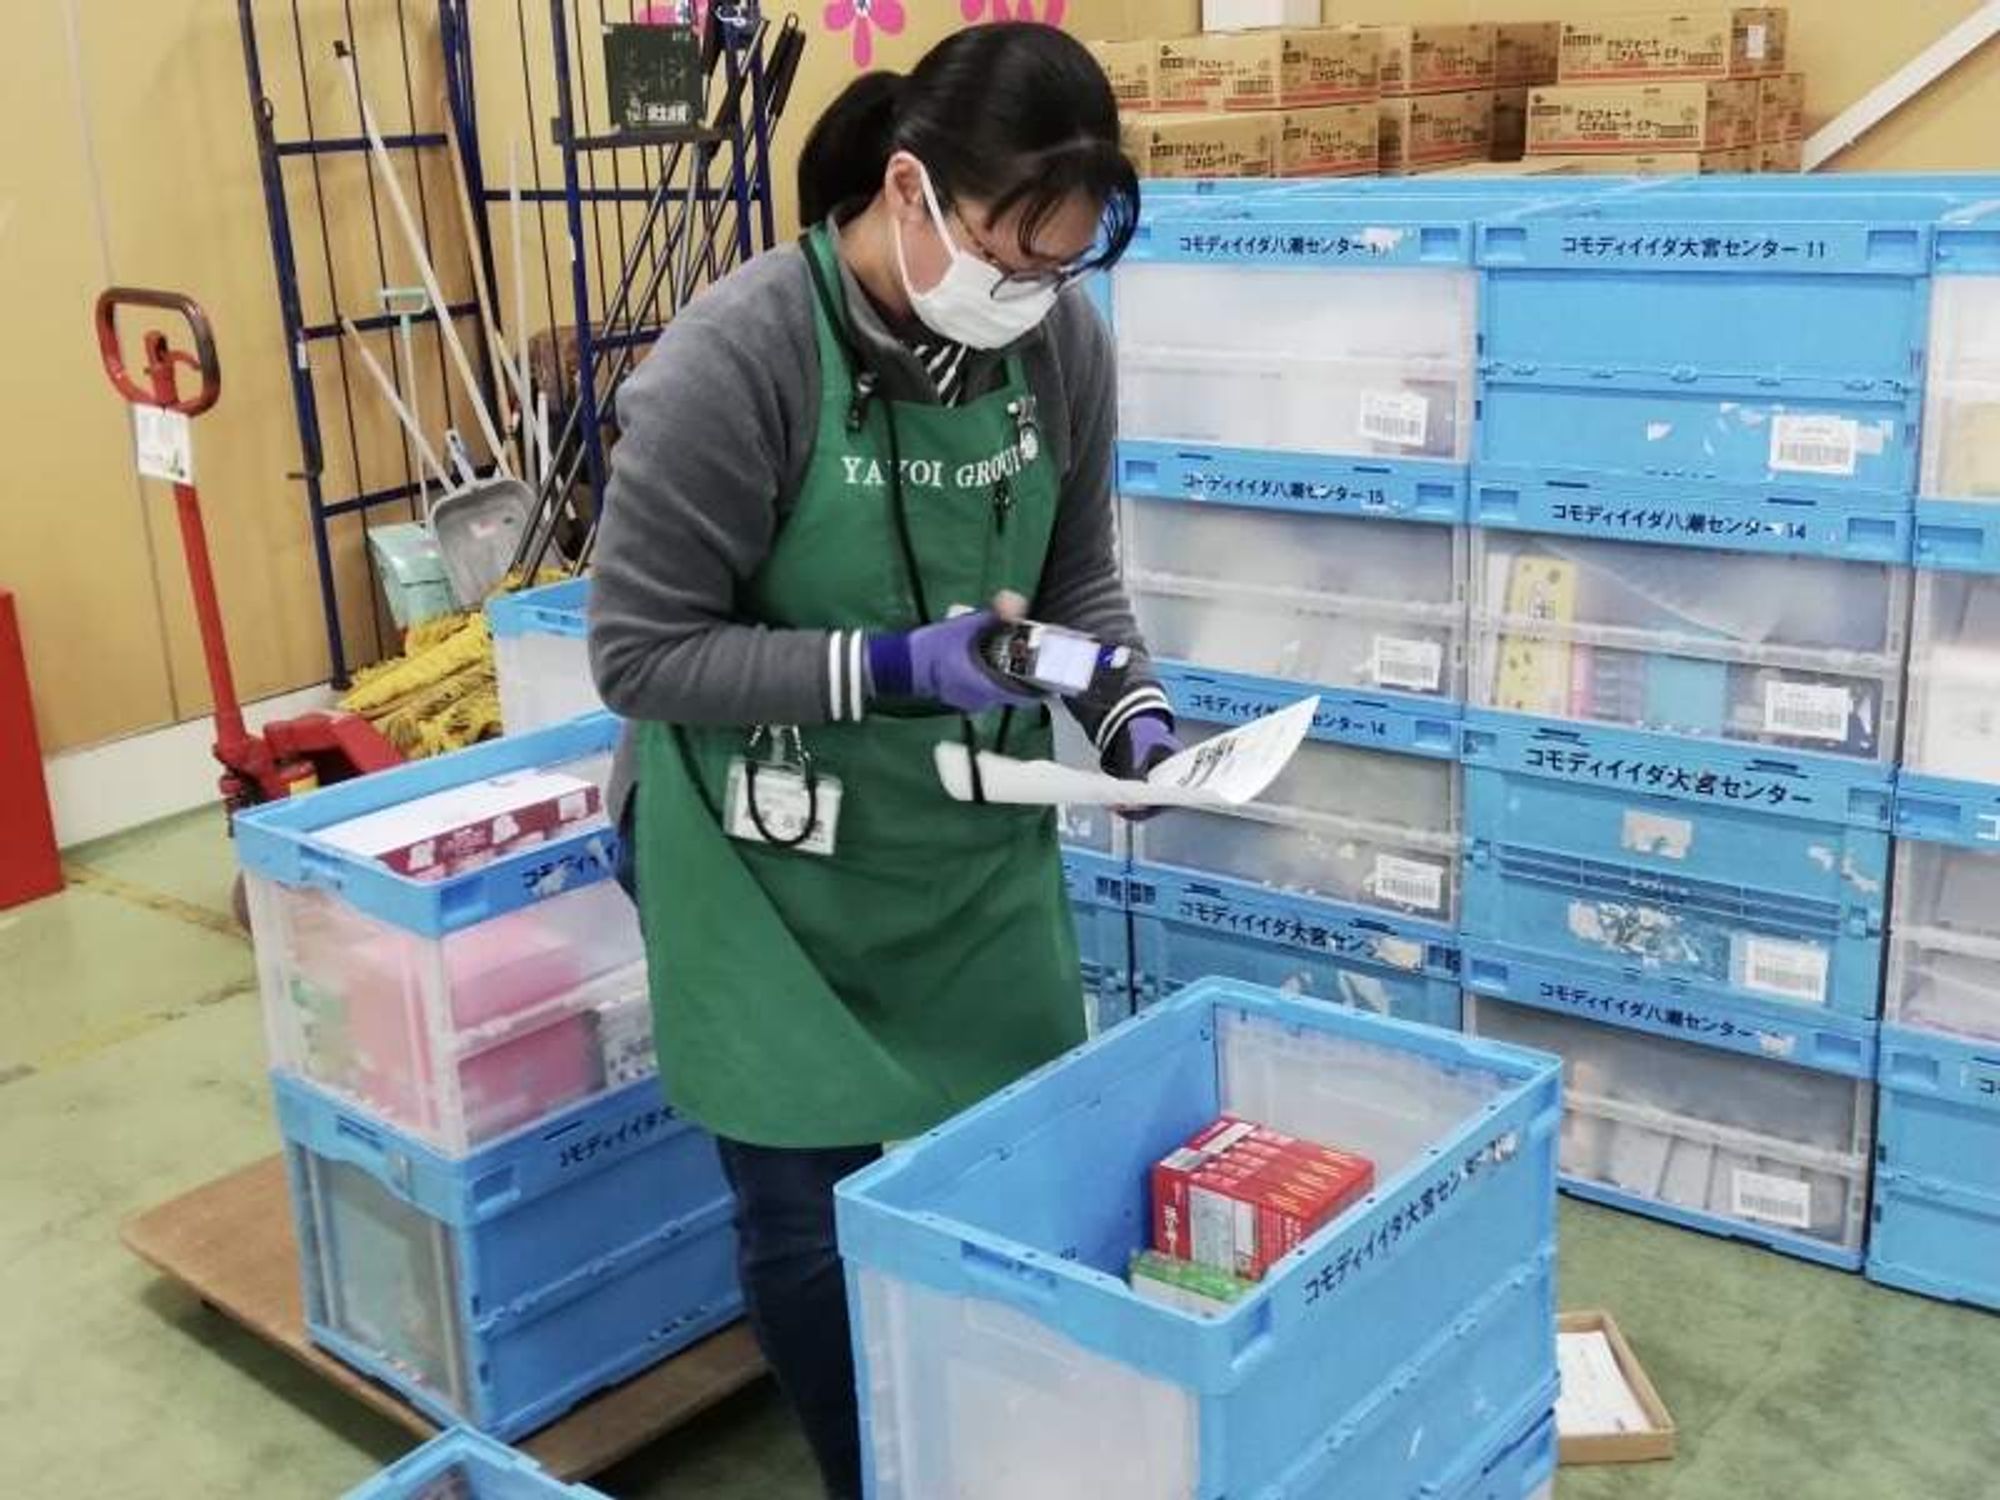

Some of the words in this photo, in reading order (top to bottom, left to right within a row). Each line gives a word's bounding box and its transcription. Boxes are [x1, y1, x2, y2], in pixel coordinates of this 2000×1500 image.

[1563, 237, 1799, 258] コモディイイダ大宮センター
[1526, 749, 1812, 804] コモディイイダ大宮センター
